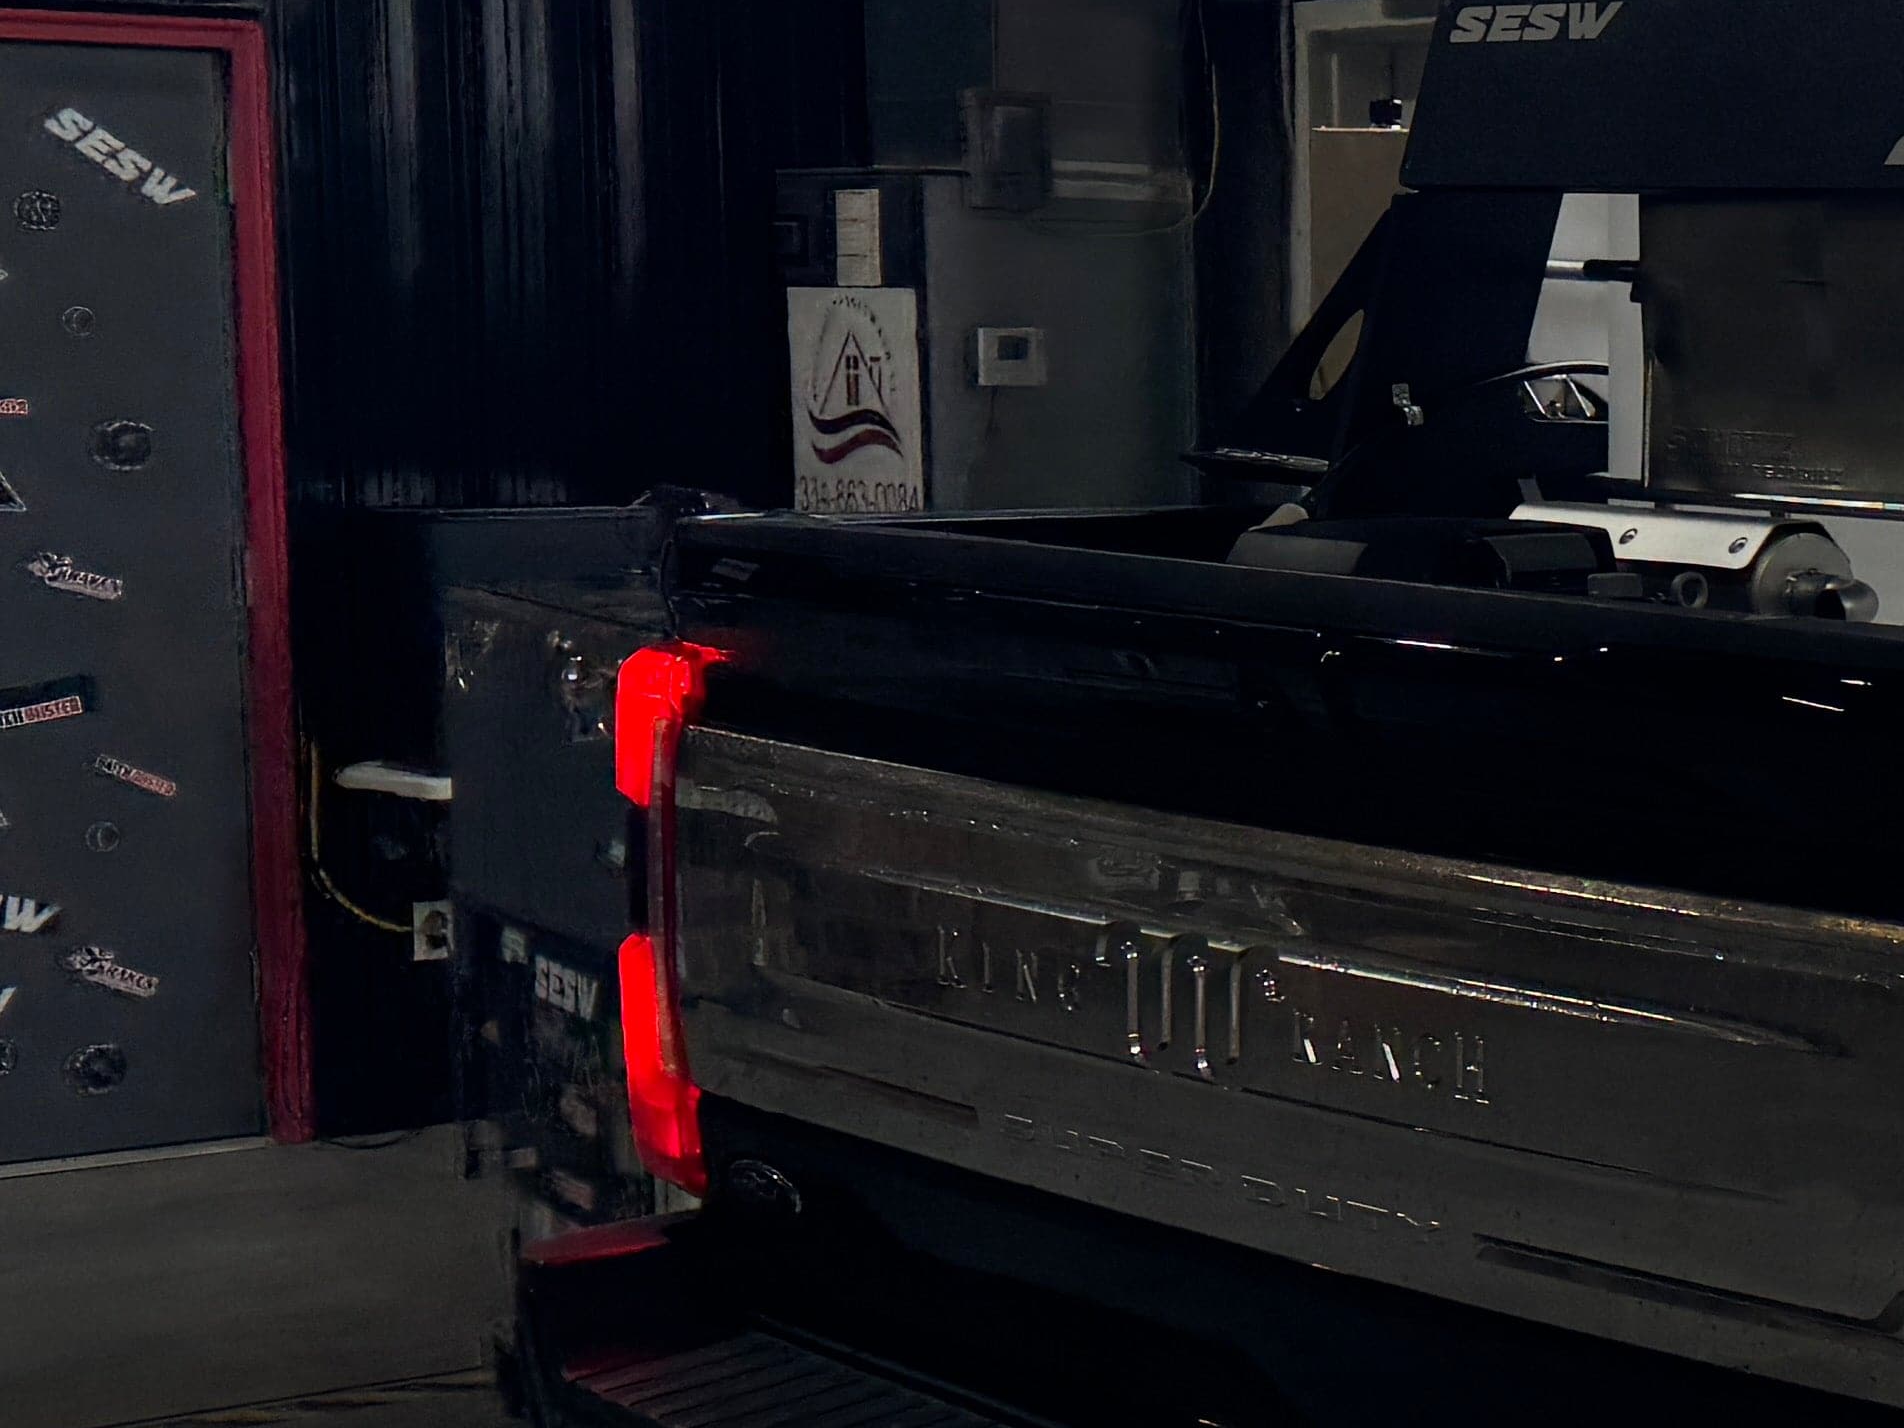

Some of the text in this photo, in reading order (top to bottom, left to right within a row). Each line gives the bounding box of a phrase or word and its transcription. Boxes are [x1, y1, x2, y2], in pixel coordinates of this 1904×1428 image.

[1450, 0, 1624, 44] SESW
[43, 107, 199, 206] SESW
[936, 923, 1492, 1106] KING RANCH
